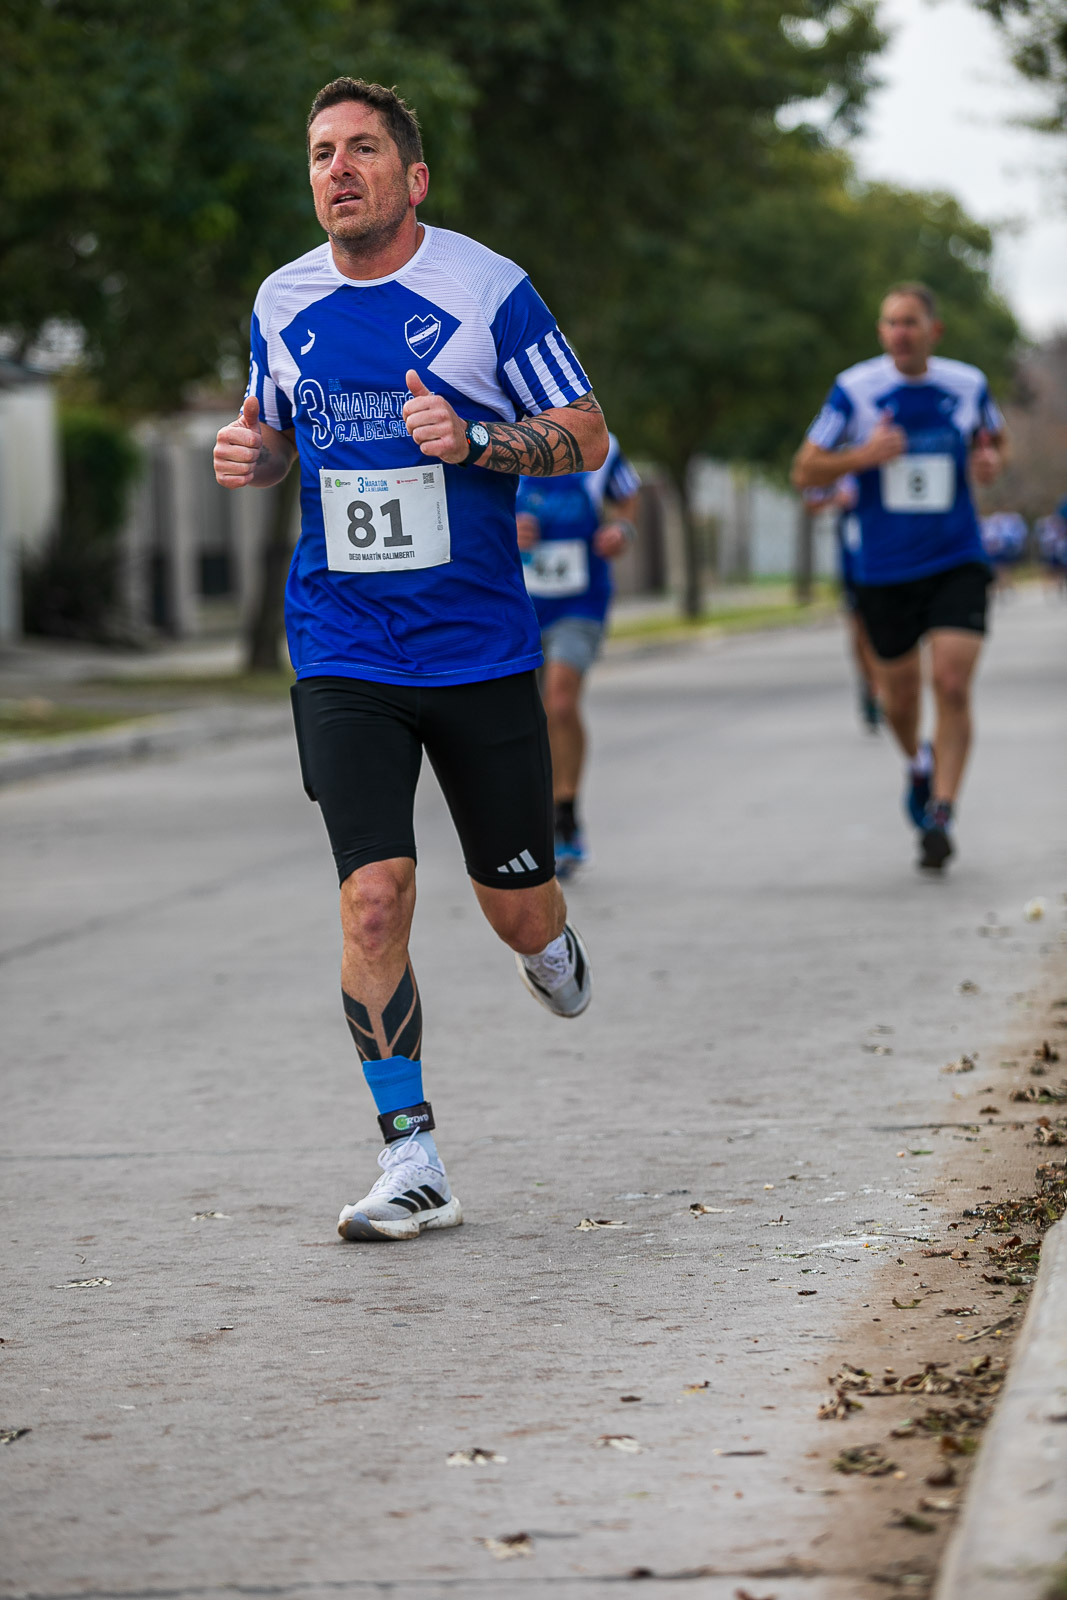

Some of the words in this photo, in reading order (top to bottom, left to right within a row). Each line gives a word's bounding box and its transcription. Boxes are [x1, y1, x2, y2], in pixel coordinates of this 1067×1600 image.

[299, 379, 334, 449] 3
[329, 391, 435, 422] MARAT
[357, 477, 364, 493] 3
[347, 499, 412, 548] 81
